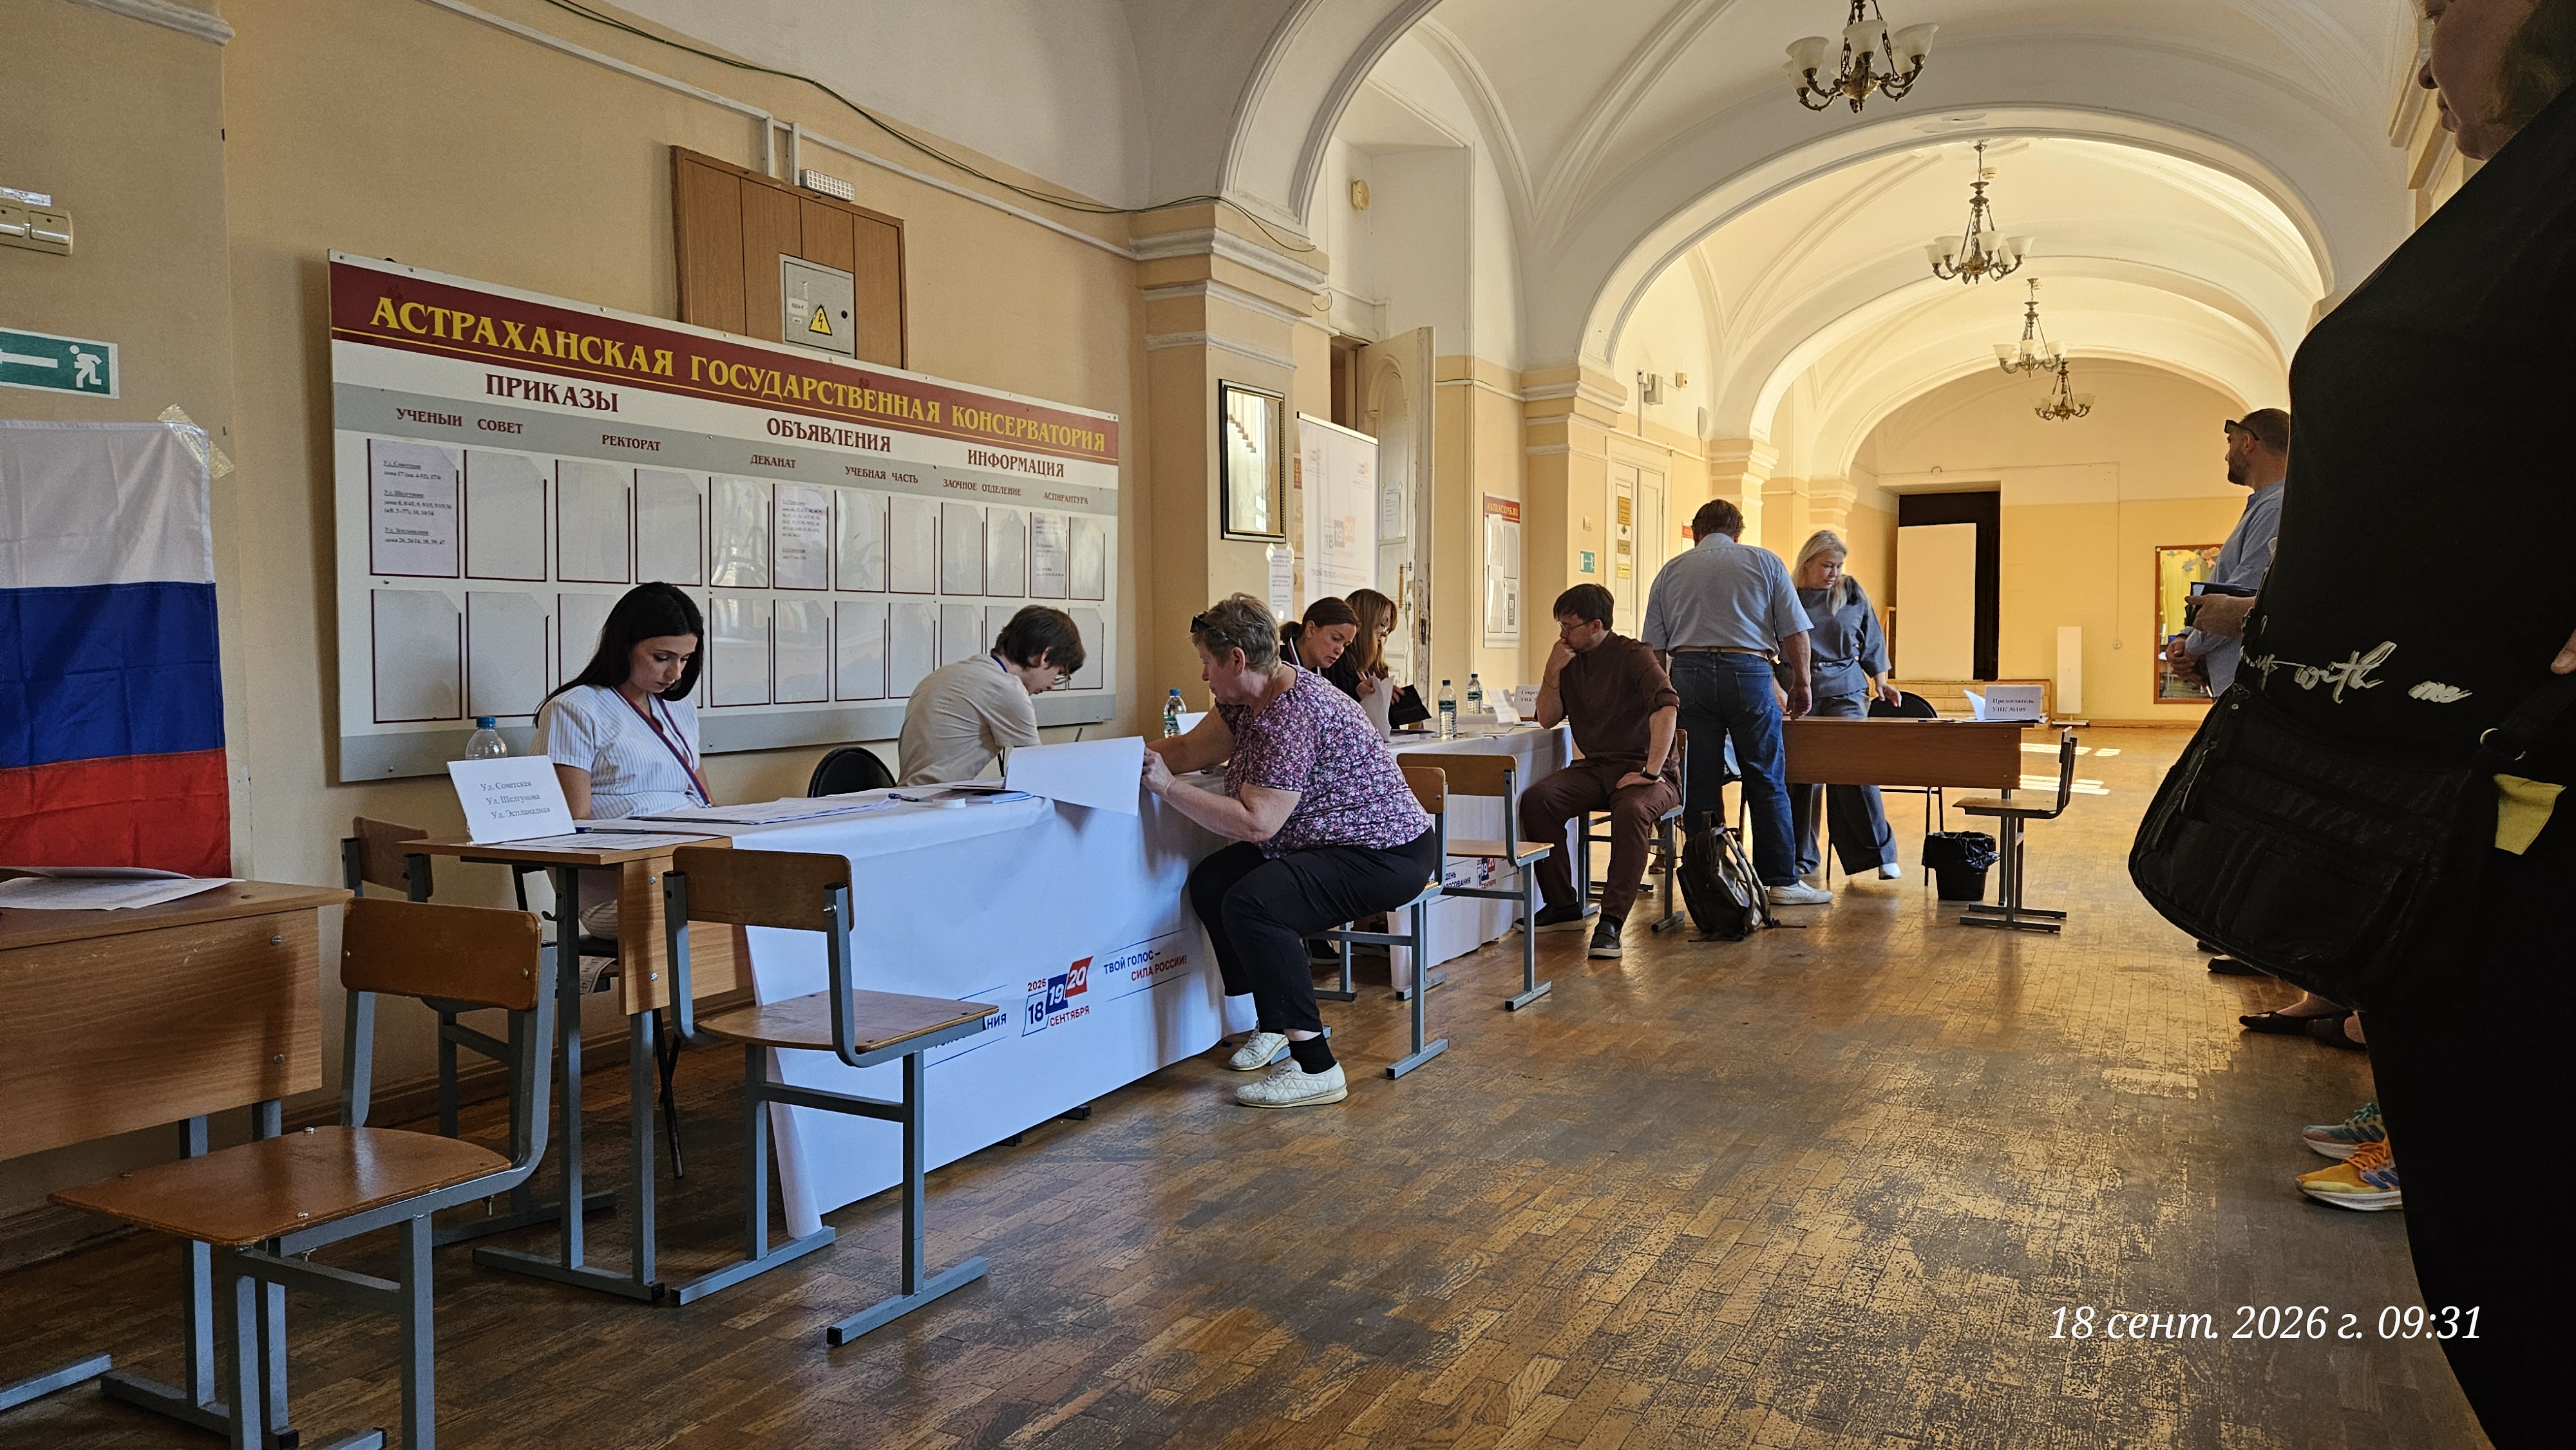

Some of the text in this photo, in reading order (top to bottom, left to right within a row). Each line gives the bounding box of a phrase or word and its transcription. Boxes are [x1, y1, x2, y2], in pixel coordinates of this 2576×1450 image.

[370, 297, 1106, 452] АСТРАХАНСКАЯ ГОСУДАРСТВЕННАЯ КОНСЕРВАТОРИЯ
[485, 373, 618, 413] ПРИКАЗЫ
[477, 419, 524, 434] СОВЕТ
[601, 435, 661, 451] РЕКТОРАТ
[766, 418, 891, 453] ОБЪЯВЛЕНИЯ
[750, 455, 797, 469] ДЕКАНАТ
[967, 449, 1065, 478] ИНФОРМАЦИЯ
[845, 466, 918, 484] УЧЕБНАЯ ЧАСТЬ
[943, 478, 1022, 496] ЗАОЧНОЕ ОТДЕЛЕНИЕ
[1043, 492, 1089, 505] АСПИРАНТУРА
[1487, 502, 1519, 516] ASTRACONS.RU
[1335, 527, 1343, 542] 19
[1344, 522, 1354, 537] 20
[1325, 534, 1334, 549] 18
[495, 780, 532, 789] Советская
[500, 794, 540, 804] Шелгунова
[505, 807, 550, 817] Эспланадная
[1104, 957, 1126, 974] ТВОЙ
[1127, 950, 1154, 967] ГОЛОС
[1132, 955, 1187, 981] СИЛА РОССИИ!
[1027, 978, 1046, 992] 2026
[1066, 966, 1087, 990] 20
[1048, 983, 1065, 1006] 19
[1028, 1001, 1044, 1024] 18
[1050, 1005, 1090, 1027] СЕНТЯБРЯ
